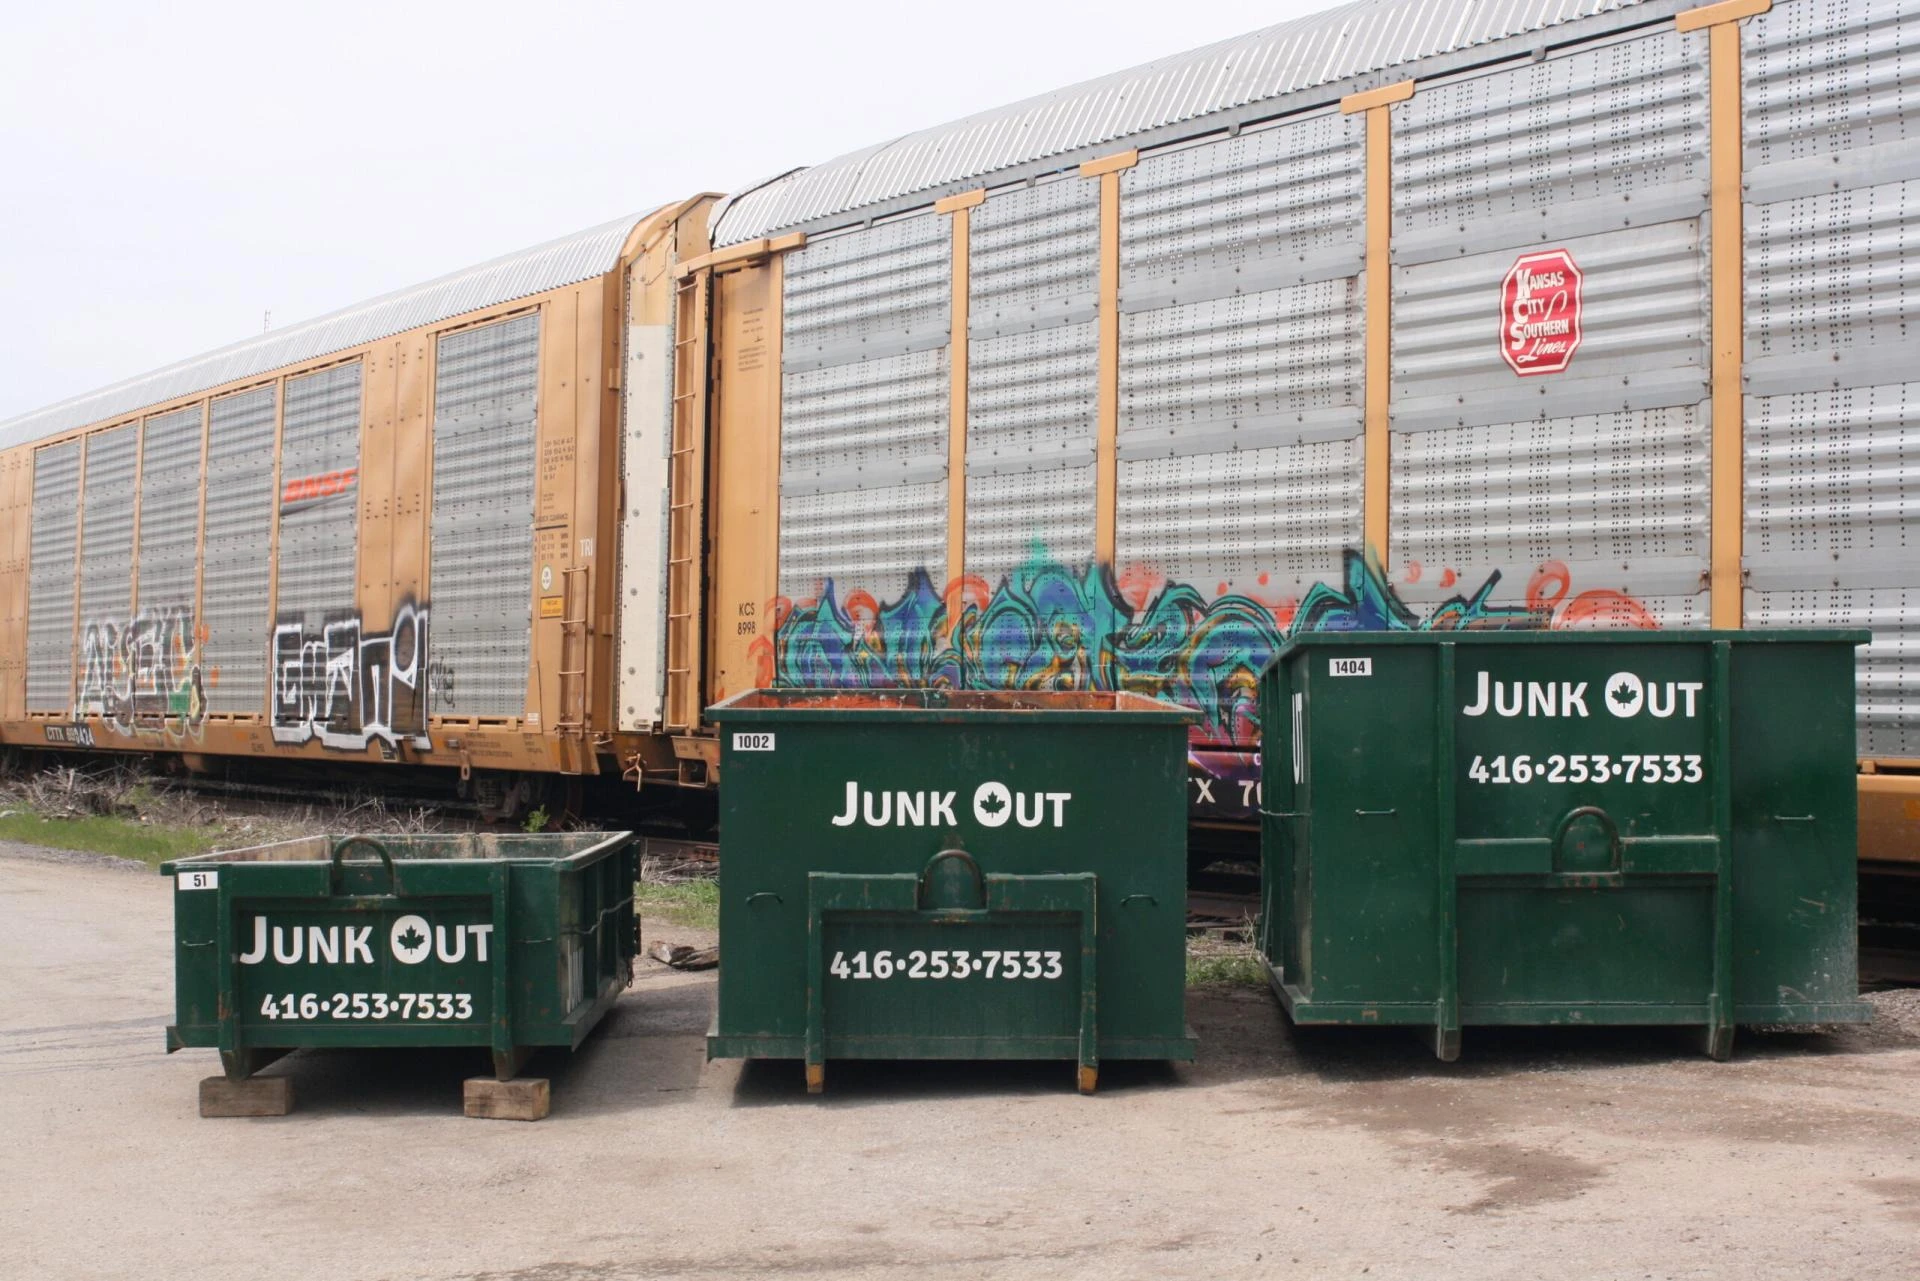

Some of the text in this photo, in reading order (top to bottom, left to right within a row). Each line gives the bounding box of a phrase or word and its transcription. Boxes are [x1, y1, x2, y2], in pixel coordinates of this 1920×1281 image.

[1516, 268, 1565, 299] KANSAS
[1512, 298, 1545, 323] CITY
[1510, 318, 1569, 350] SOUTHERN
[1517, 338, 1567, 363] Lines
[283, 468, 359, 503] BNSF
[738, 602, 755, 616] KCS
[737, 621, 756, 635] 8998
[1335, 660, 1366, 674] 1404
[46, 725, 65, 741] CTTX
[738, 735, 769, 749] 1002
[1188, 777, 1216, 804] X
[193, 874, 207, 887] 51
